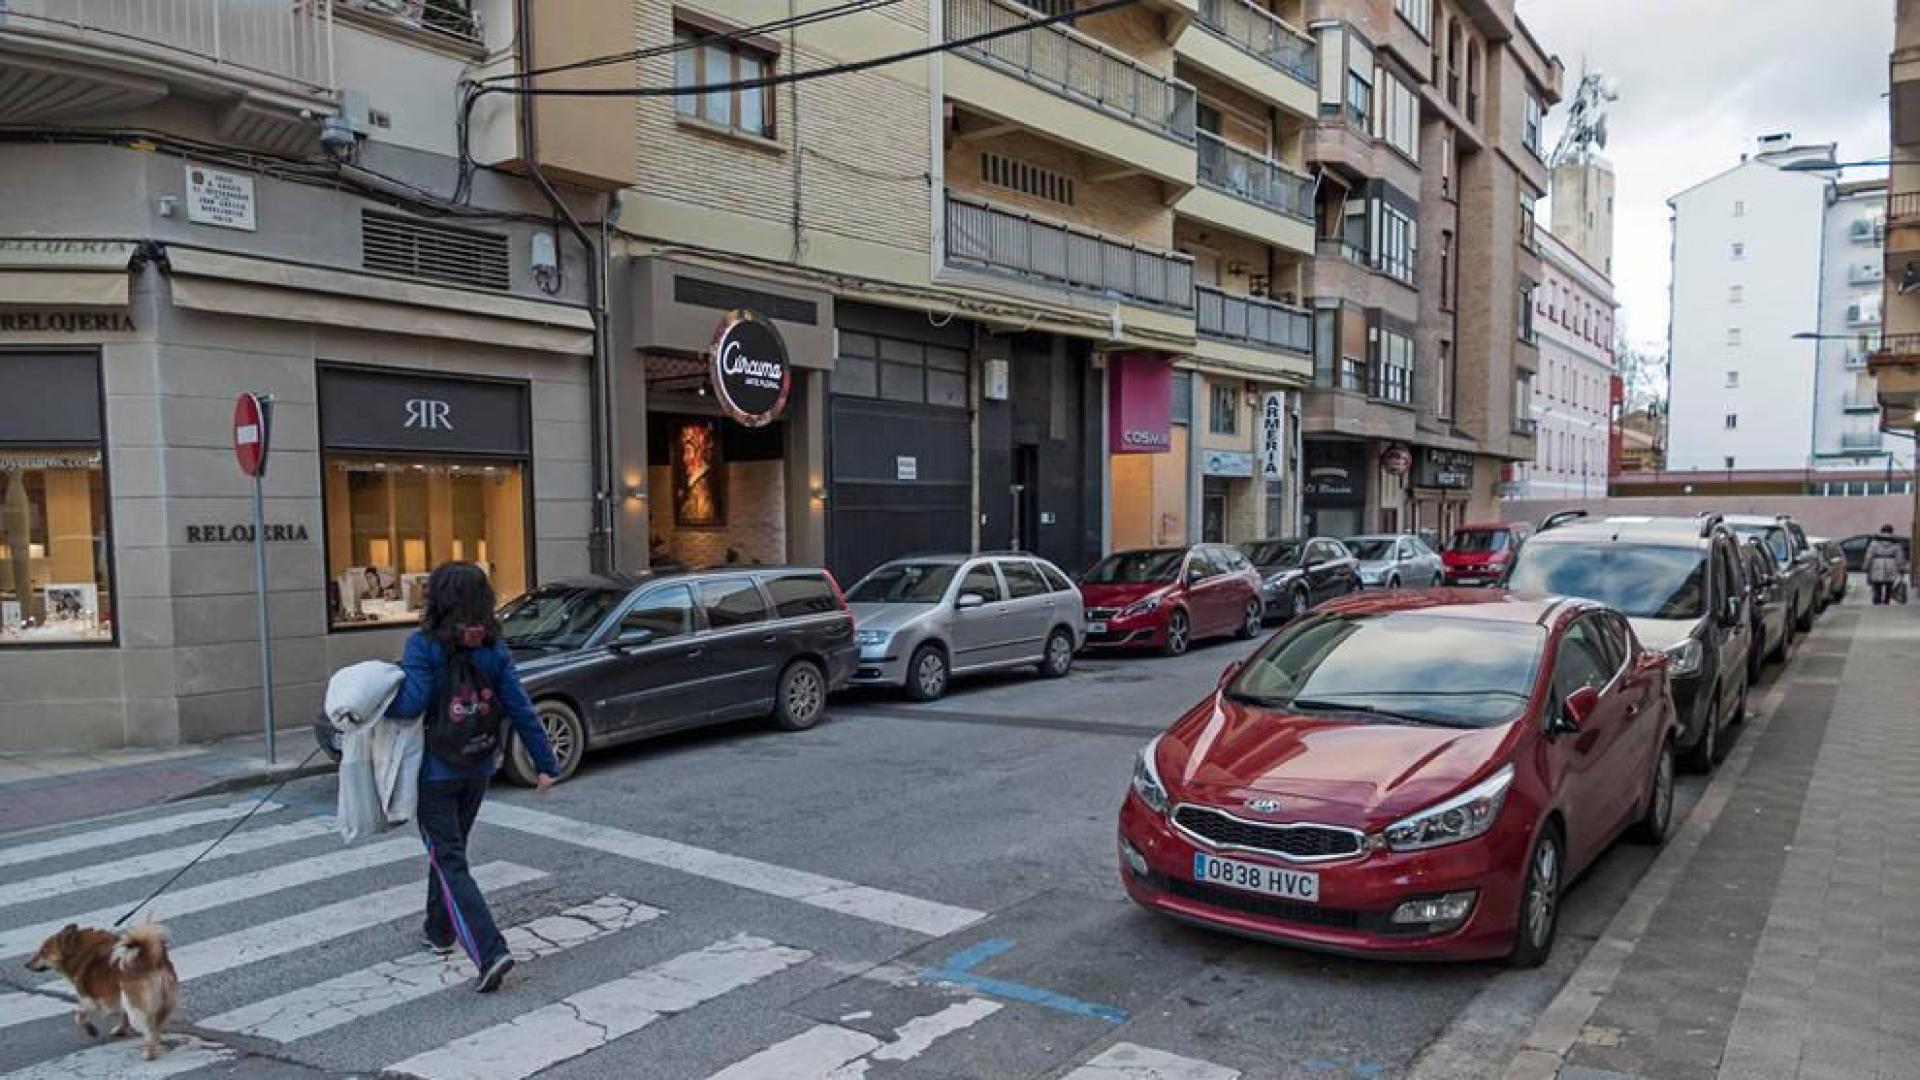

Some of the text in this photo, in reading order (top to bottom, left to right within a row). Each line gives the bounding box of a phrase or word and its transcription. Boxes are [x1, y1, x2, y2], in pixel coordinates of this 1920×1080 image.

[1, 312, 137, 332] RELOJERIA
[1264, 396, 1279, 473] ARMERIA
[186, 524, 309, 542] RELOJERIA
[1209, 859, 1313, 897] 0838 HVC
